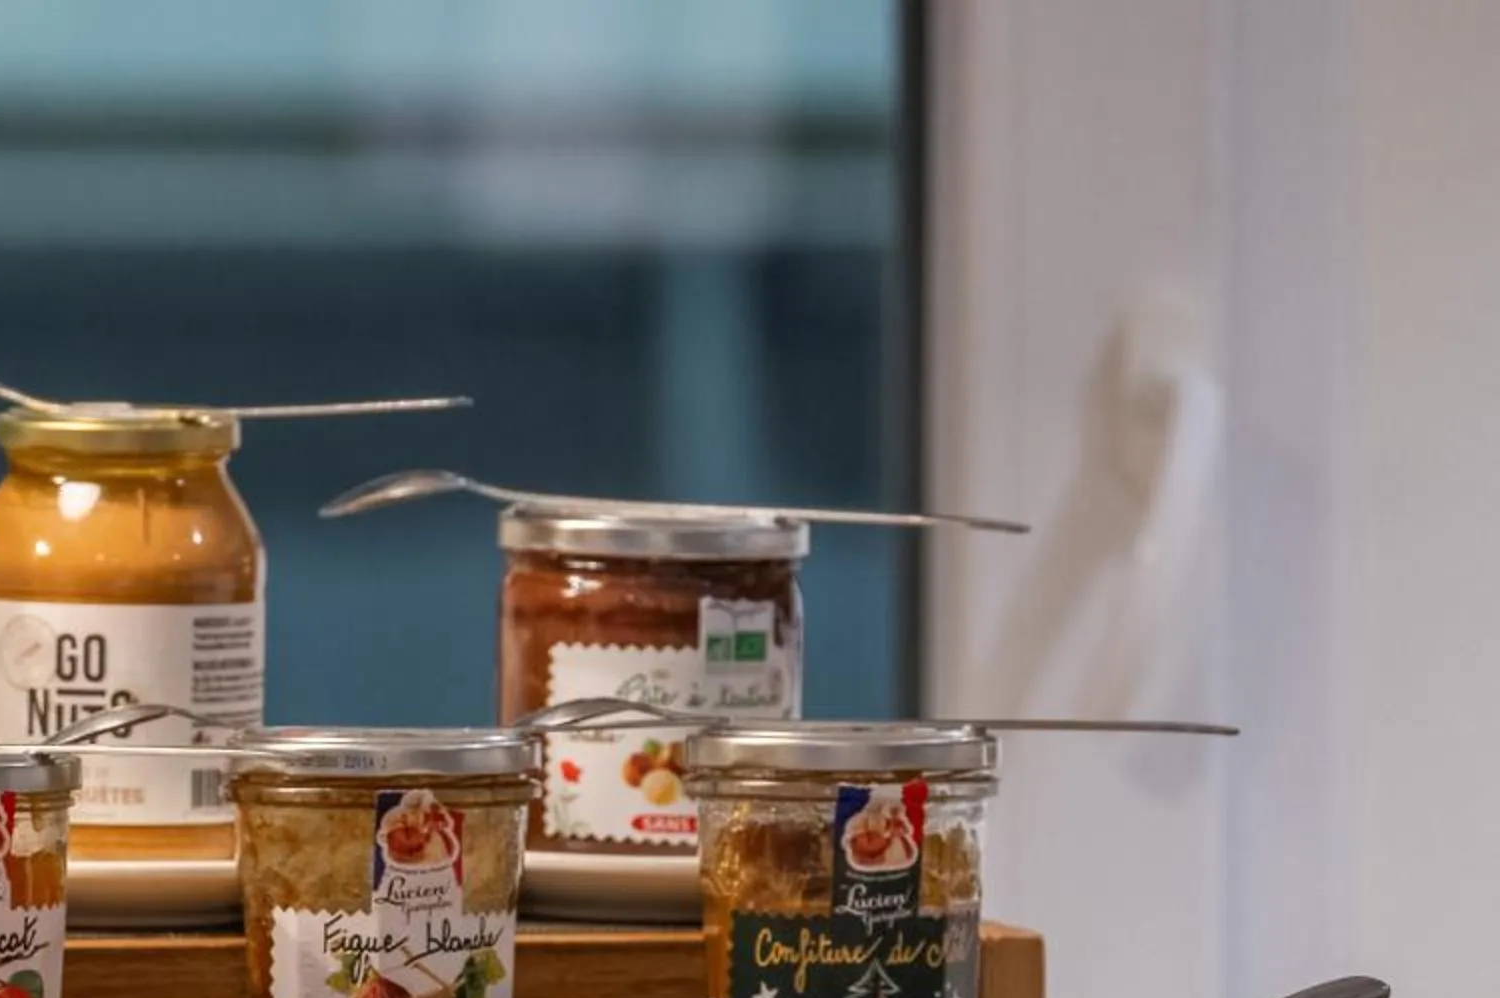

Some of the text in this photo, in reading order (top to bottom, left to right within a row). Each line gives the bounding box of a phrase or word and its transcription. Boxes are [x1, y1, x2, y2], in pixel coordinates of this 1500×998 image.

[56, 633, 106, 682] GO
[375, 875, 451, 906] Lucien
[835, 884, 913, 915] Lucien
[323, 913, 503, 982] Figue blanche
[755, 927, 882, 992] Confiture
[886, 931, 926, 966] de
